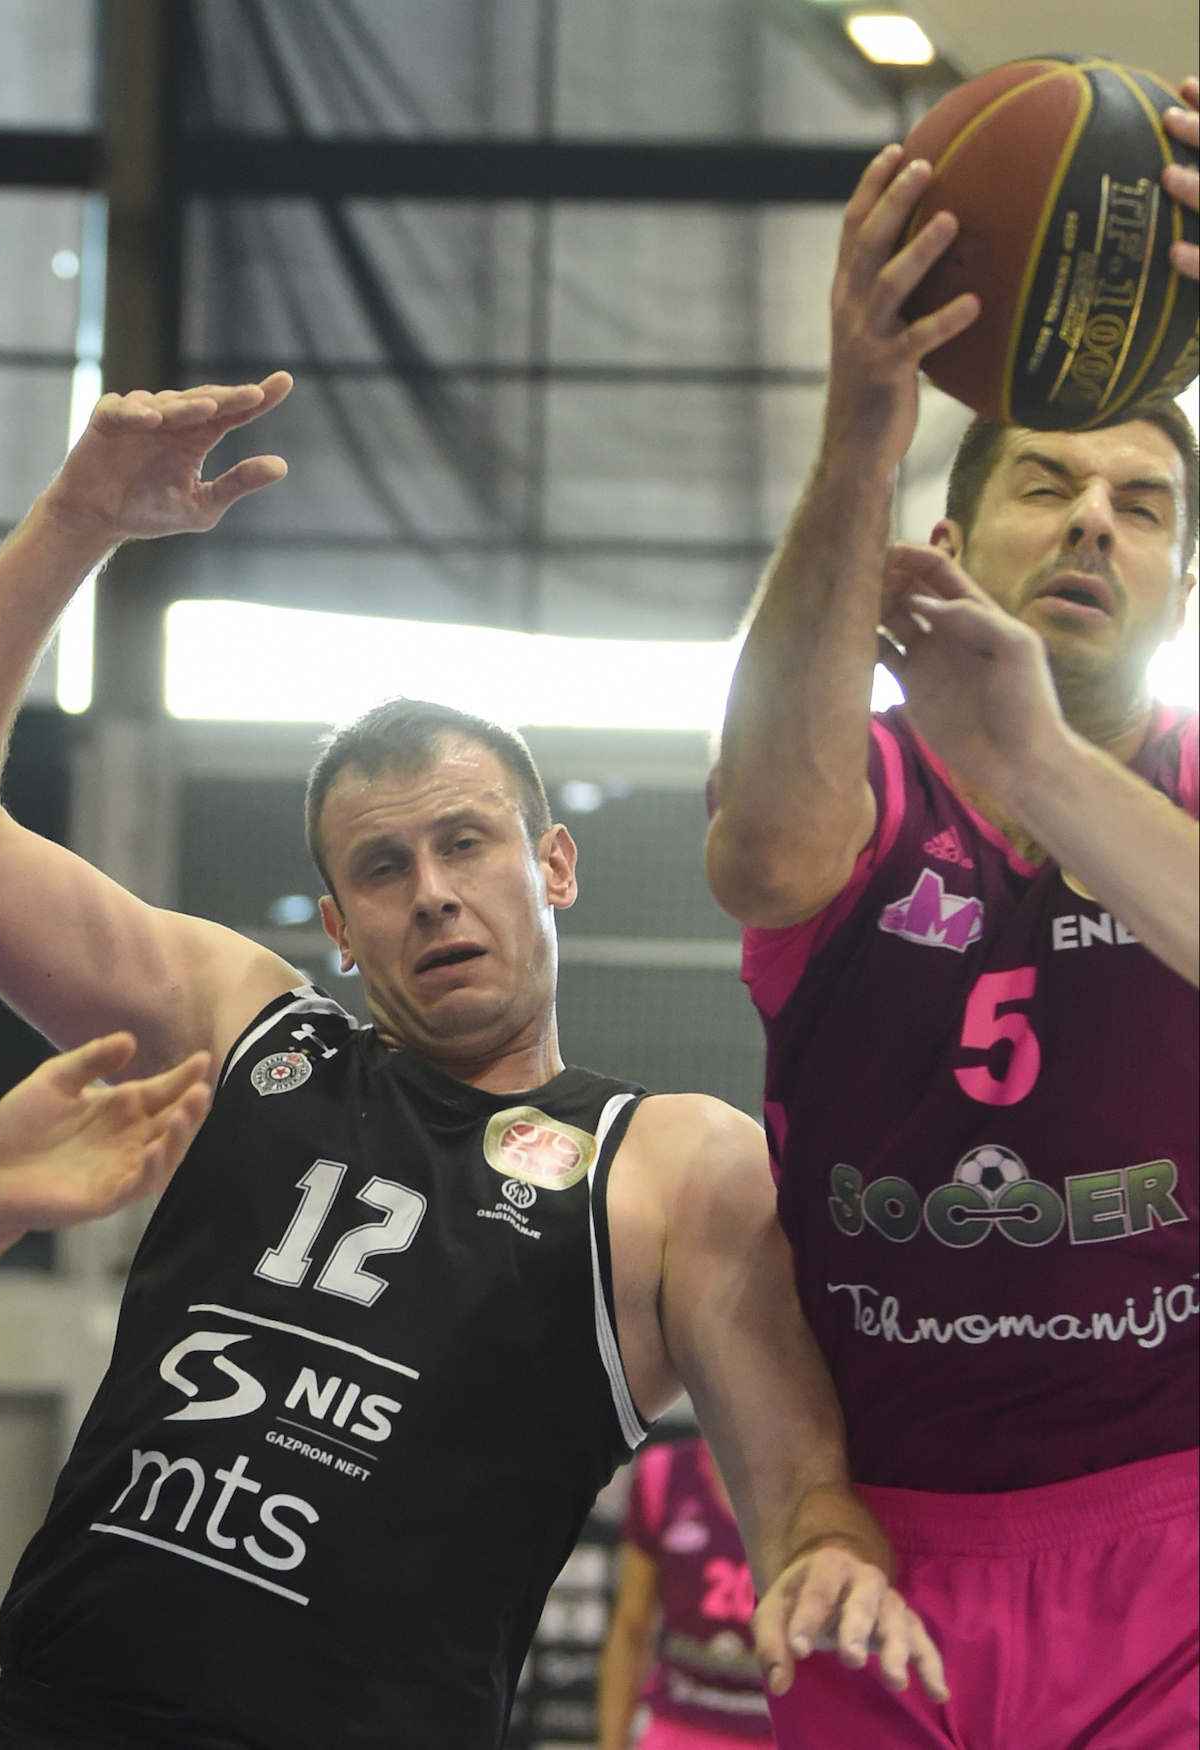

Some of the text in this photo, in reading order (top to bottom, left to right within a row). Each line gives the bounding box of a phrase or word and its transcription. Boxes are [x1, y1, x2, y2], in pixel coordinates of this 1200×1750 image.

[953, 966, 1041, 1107] 5
[253, 1158, 428, 1308] 12
[476, 1209, 542, 1240] OSIGURANJE
[495, 1203, 530, 1224] DUNAV
[827, 1157, 1188, 1248] SOCCER
[826, 1282, 1199, 1349] Tehnomanija
[284, 1366, 403, 1443] NIS
[265, 1430, 372, 1482] GAZPROM NEFT
[110, 1448, 321, 1571] mts
